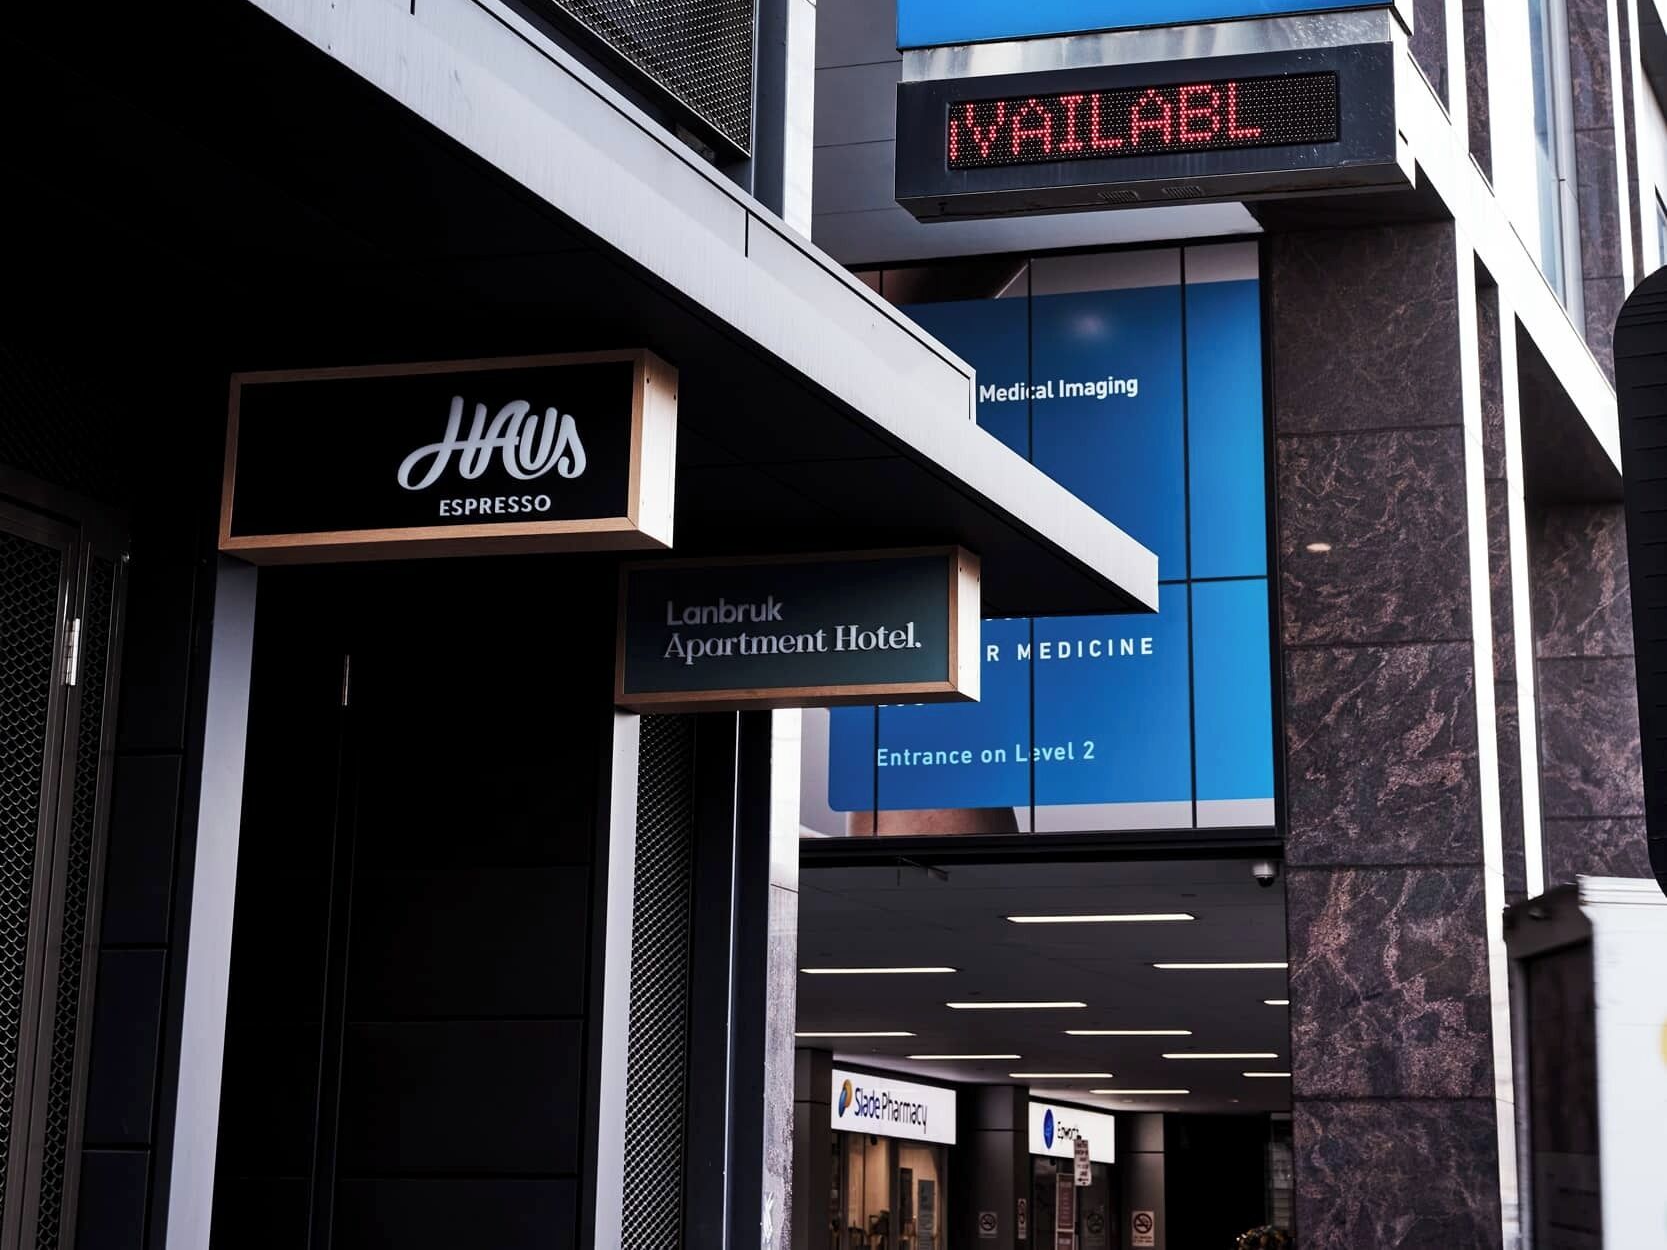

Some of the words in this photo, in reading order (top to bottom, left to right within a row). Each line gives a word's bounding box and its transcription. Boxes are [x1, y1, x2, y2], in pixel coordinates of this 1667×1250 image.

[949, 81, 1263, 161] VAILABL
[979, 380, 1055, 403] Medical
[1058, 375, 1139, 399] Imaging
[439, 494, 552, 517] ESPRESSO
[666, 595, 784, 626] Lanbruk
[663, 627, 828, 665] Apartment
[833, 621, 922, 651] Hotel.
[1017, 636, 1153, 661] MEDICINE
[876, 748, 973, 767] Entrance
[980, 748, 1007, 764] on
[1015, 741, 1075, 762] Level
[1083, 740, 1095, 760] 2
[854, 1086, 880, 1120] Slade
[881, 1090, 928, 1135] Pharmacy
